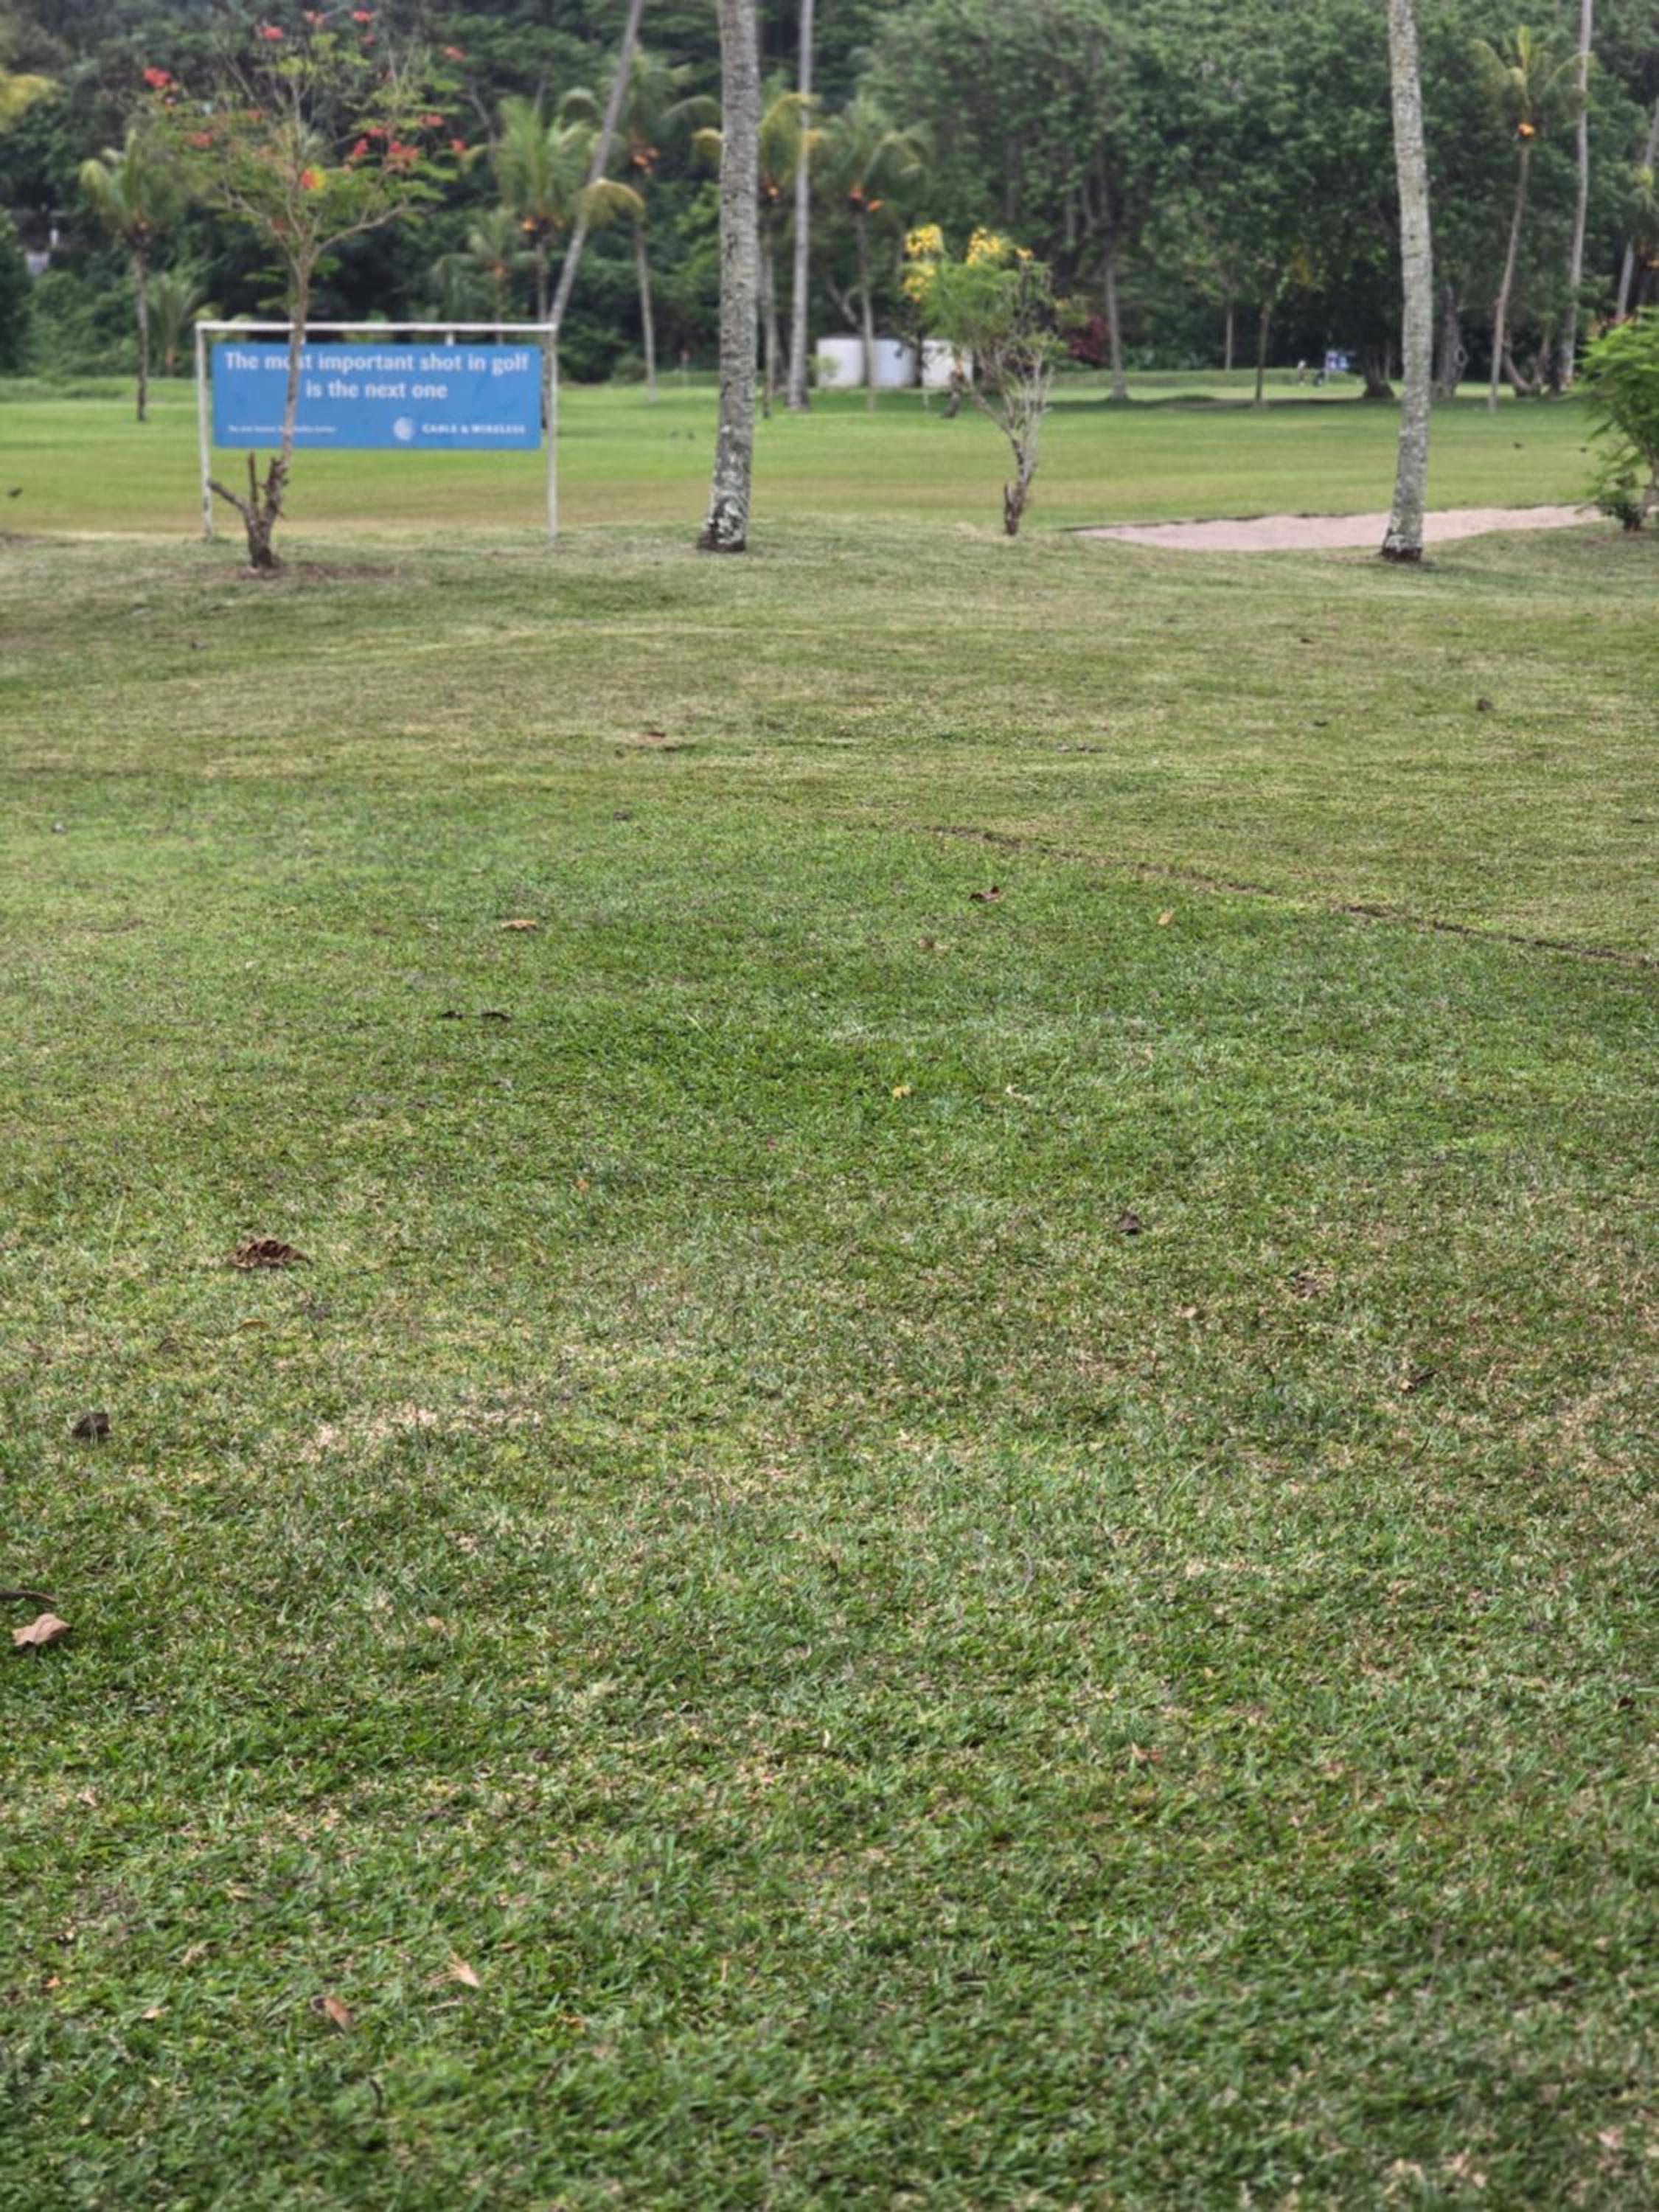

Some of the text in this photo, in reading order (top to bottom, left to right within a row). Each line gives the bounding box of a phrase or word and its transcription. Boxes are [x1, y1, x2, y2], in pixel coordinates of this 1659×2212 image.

[224, 351, 259, 370] The
[319, 352, 414, 374] important
[420, 352, 461, 370] shot
[468, 352, 485, 370] in
[492, 353, 529, 375] golf
[306, 380, 448, 397] is the next one
